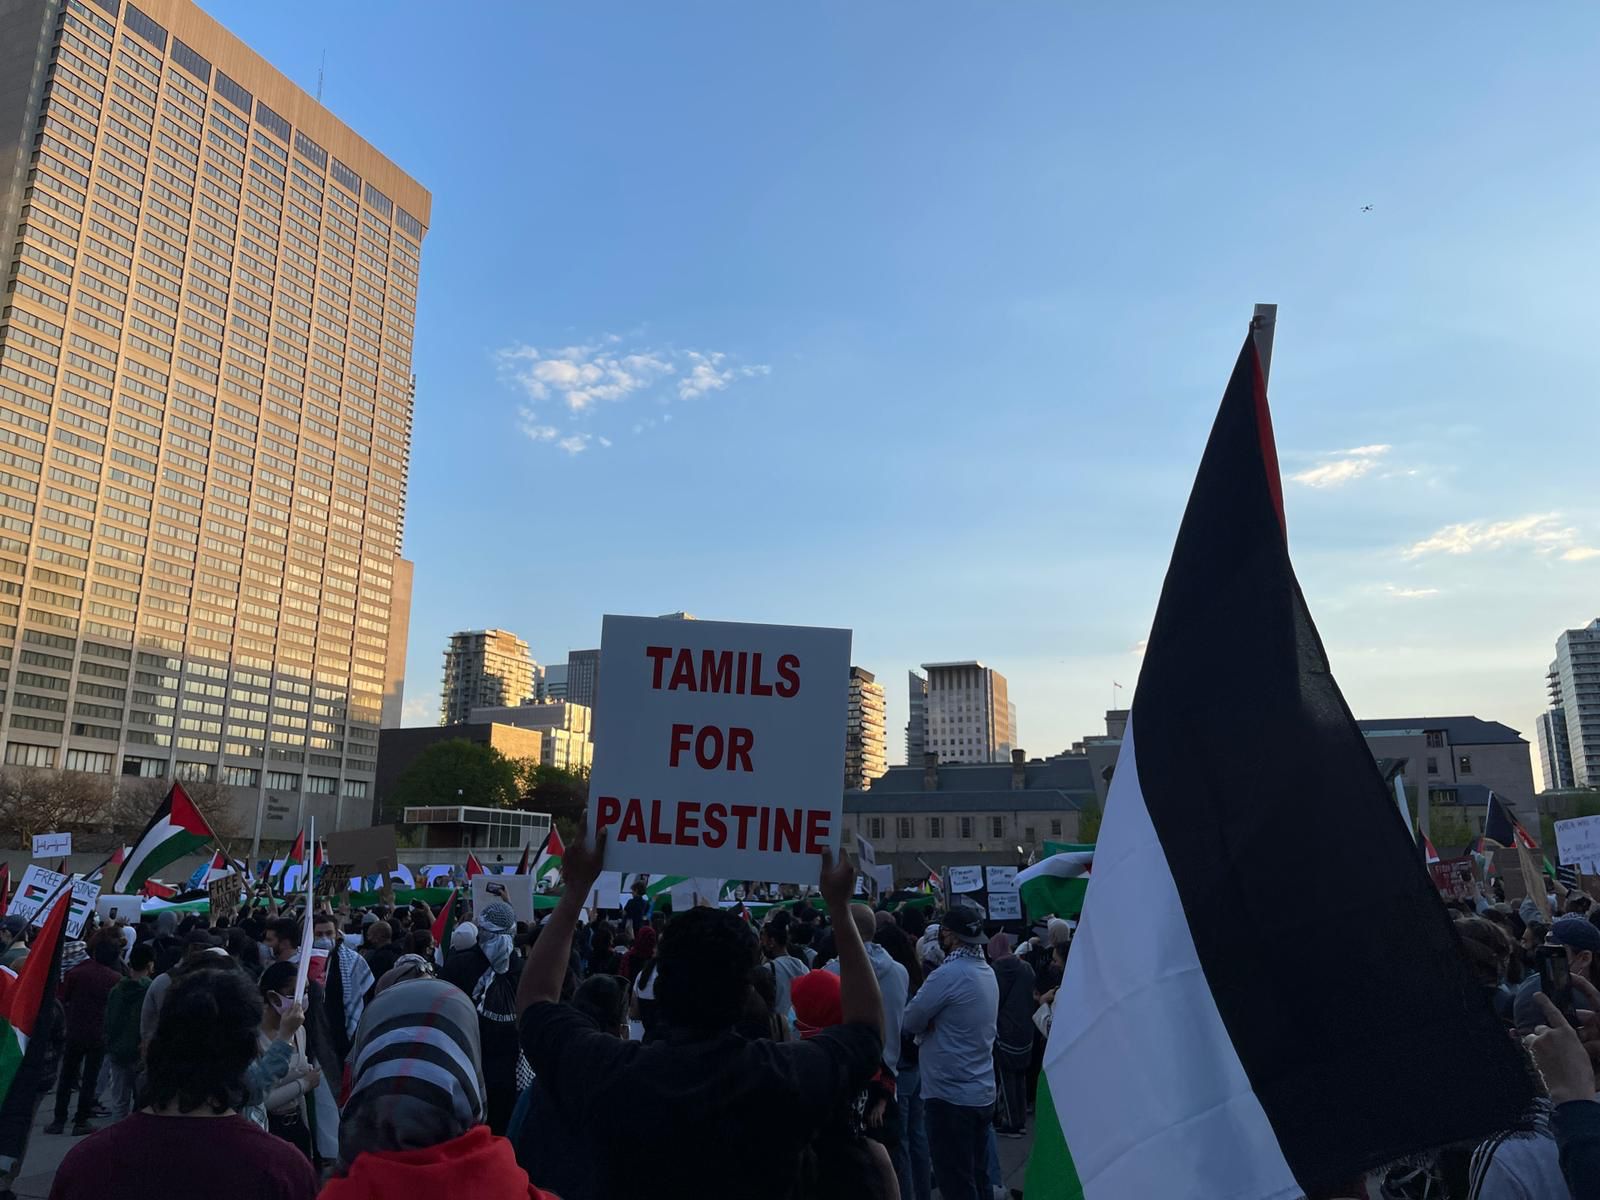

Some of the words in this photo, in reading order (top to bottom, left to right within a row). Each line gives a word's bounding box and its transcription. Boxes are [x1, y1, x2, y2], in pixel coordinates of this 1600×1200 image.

[646, 646, 800, 698] TAMILS
[669, 723, 754, 772] FOR
[595, 796, 831, 854] PALESTINE
[33, 868, 61, 888] FREE
[209, 874, 238, 895] FREE
